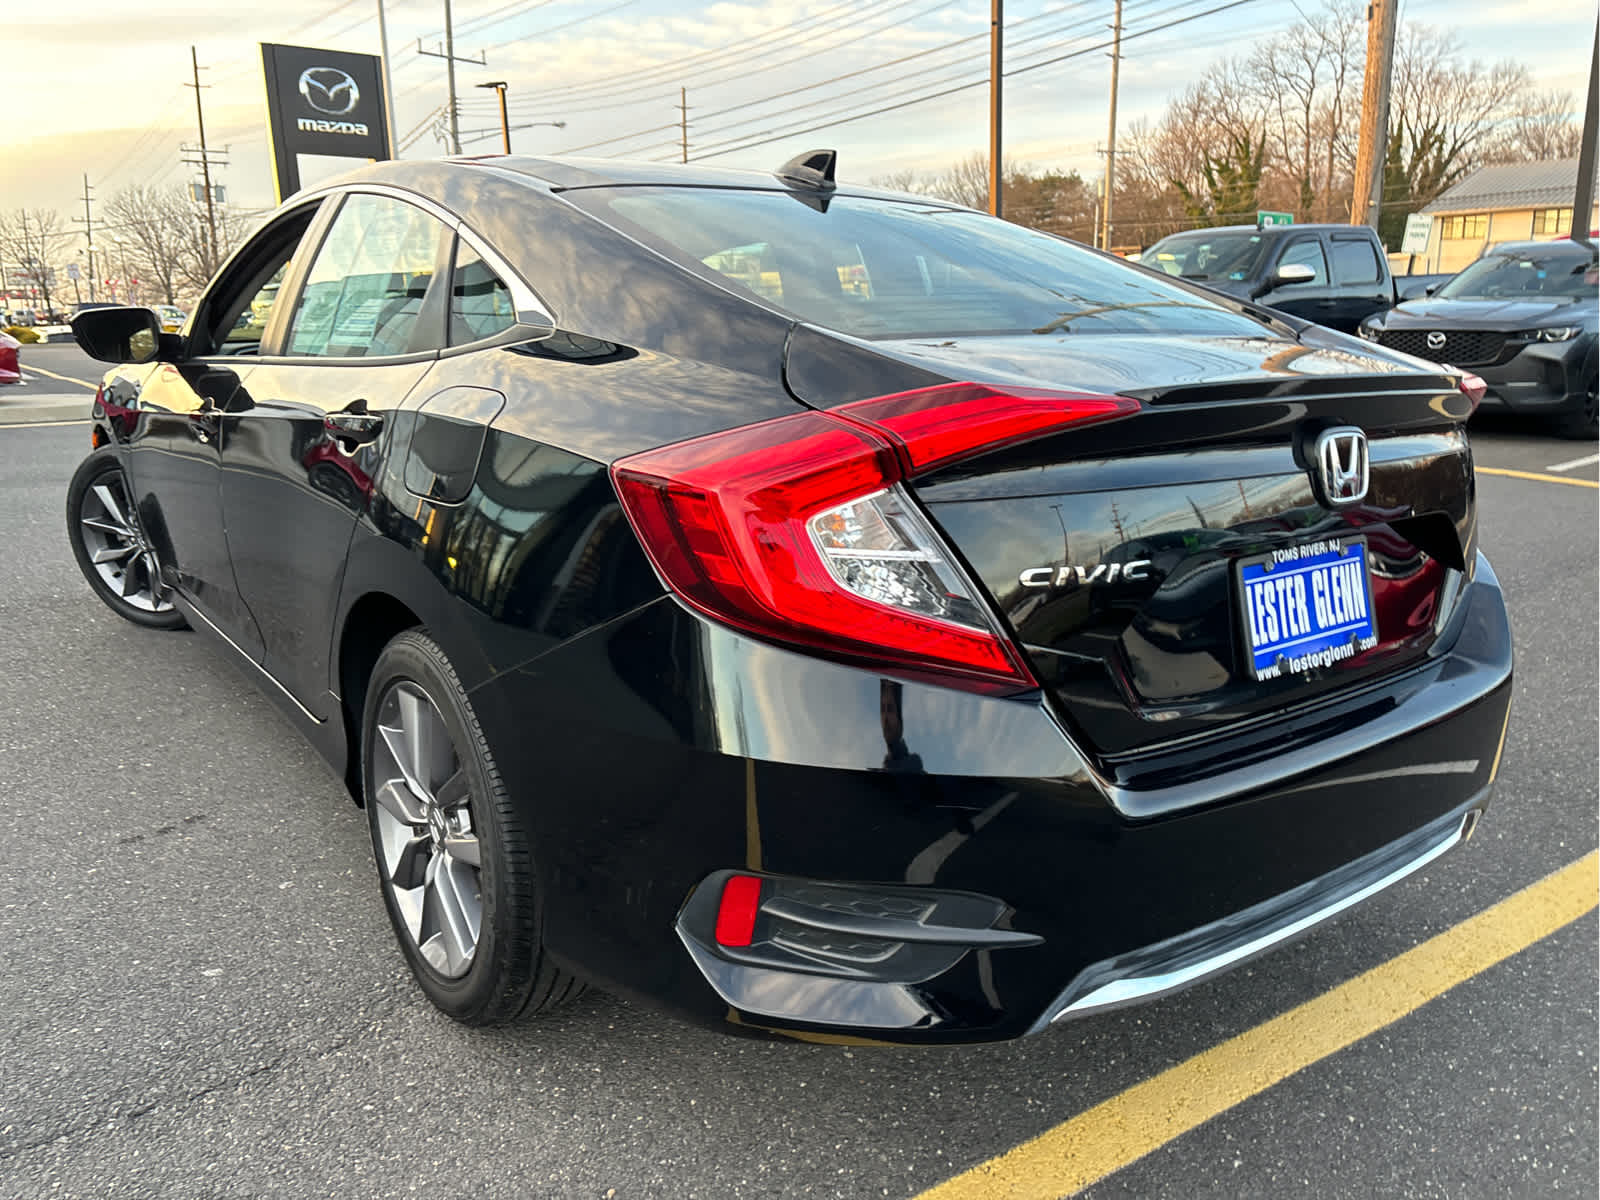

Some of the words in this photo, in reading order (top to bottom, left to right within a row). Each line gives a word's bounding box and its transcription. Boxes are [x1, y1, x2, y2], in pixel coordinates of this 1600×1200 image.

[1272, 546, 1299, 564] TOMS
[1329, 538, 1341, 552] NJ
[1019, 559, 1152, 587] CIVIC
[1245, 574, 1311, 647] LESTER
[1311, 561, 1367, 629] GLENN
